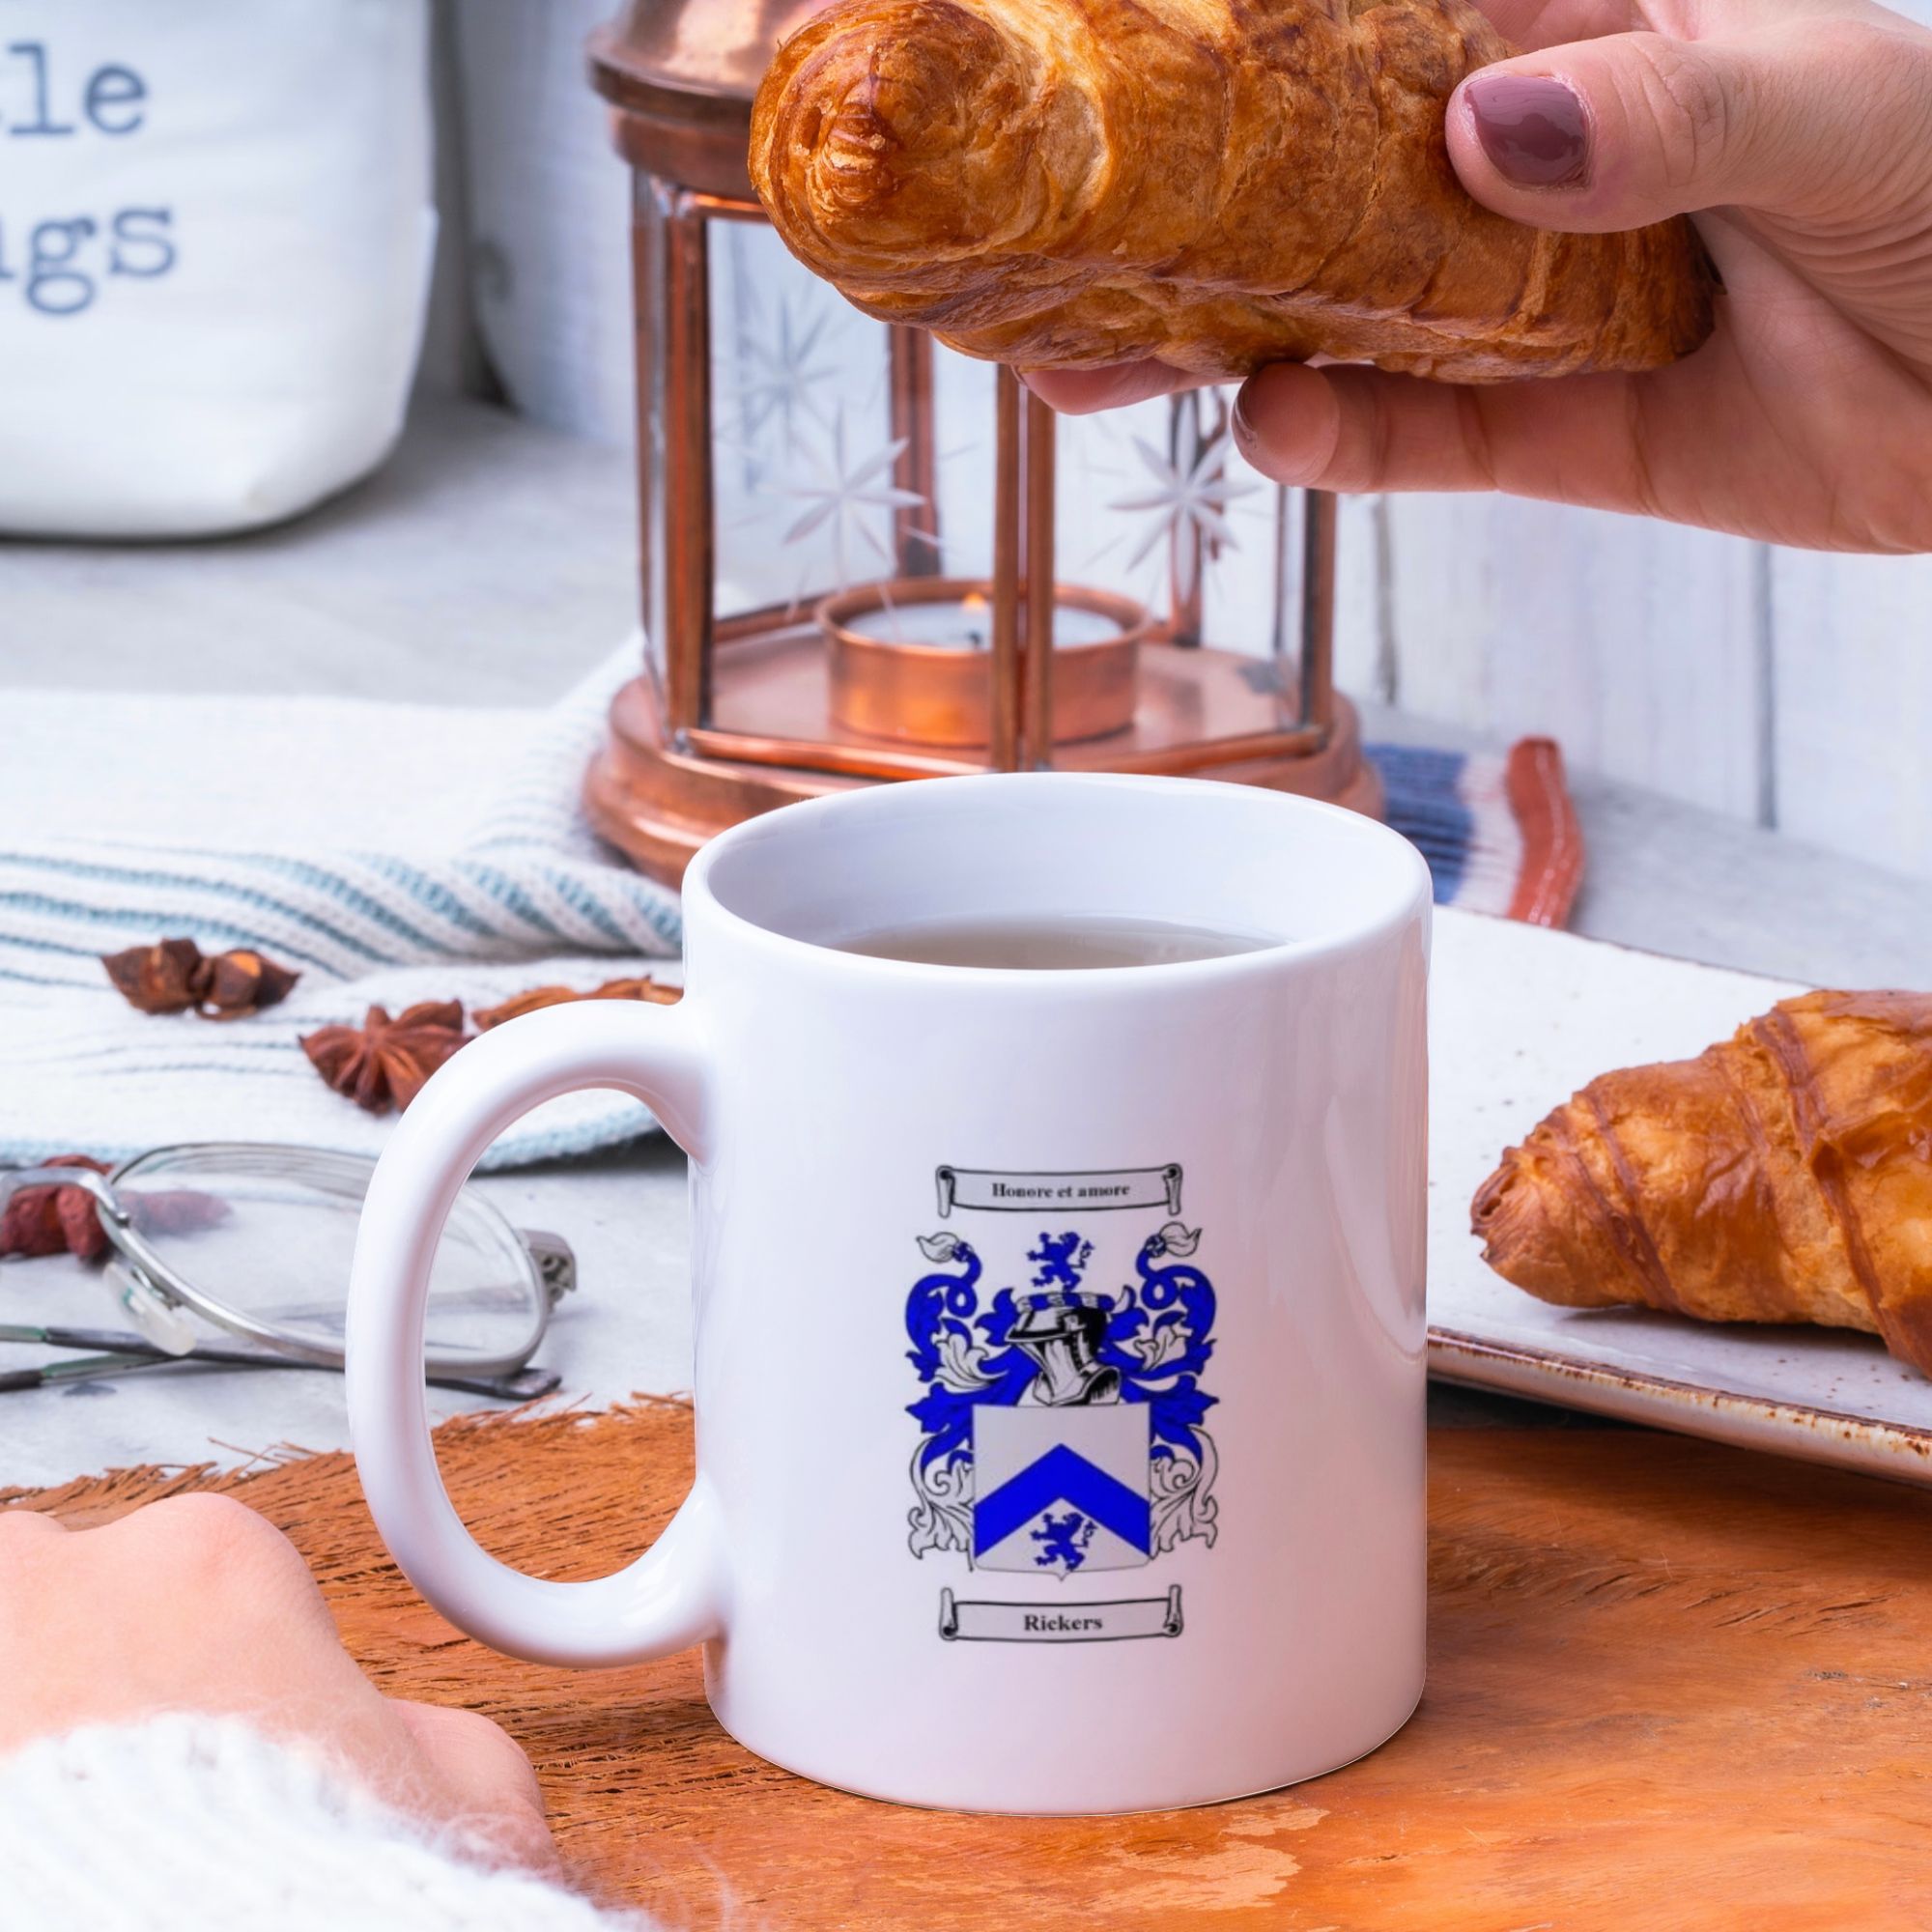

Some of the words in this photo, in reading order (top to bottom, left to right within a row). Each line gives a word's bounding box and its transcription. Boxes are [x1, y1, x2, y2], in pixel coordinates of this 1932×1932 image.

[0, 41, 150, 137] le
[991, 1181, 1053, 1198] Honore
[1057, 1184, 1073, 1198] et
[1077, 1184, 1130, 1197] amore
[1023, 1614, 1103, 1632] Rickers
